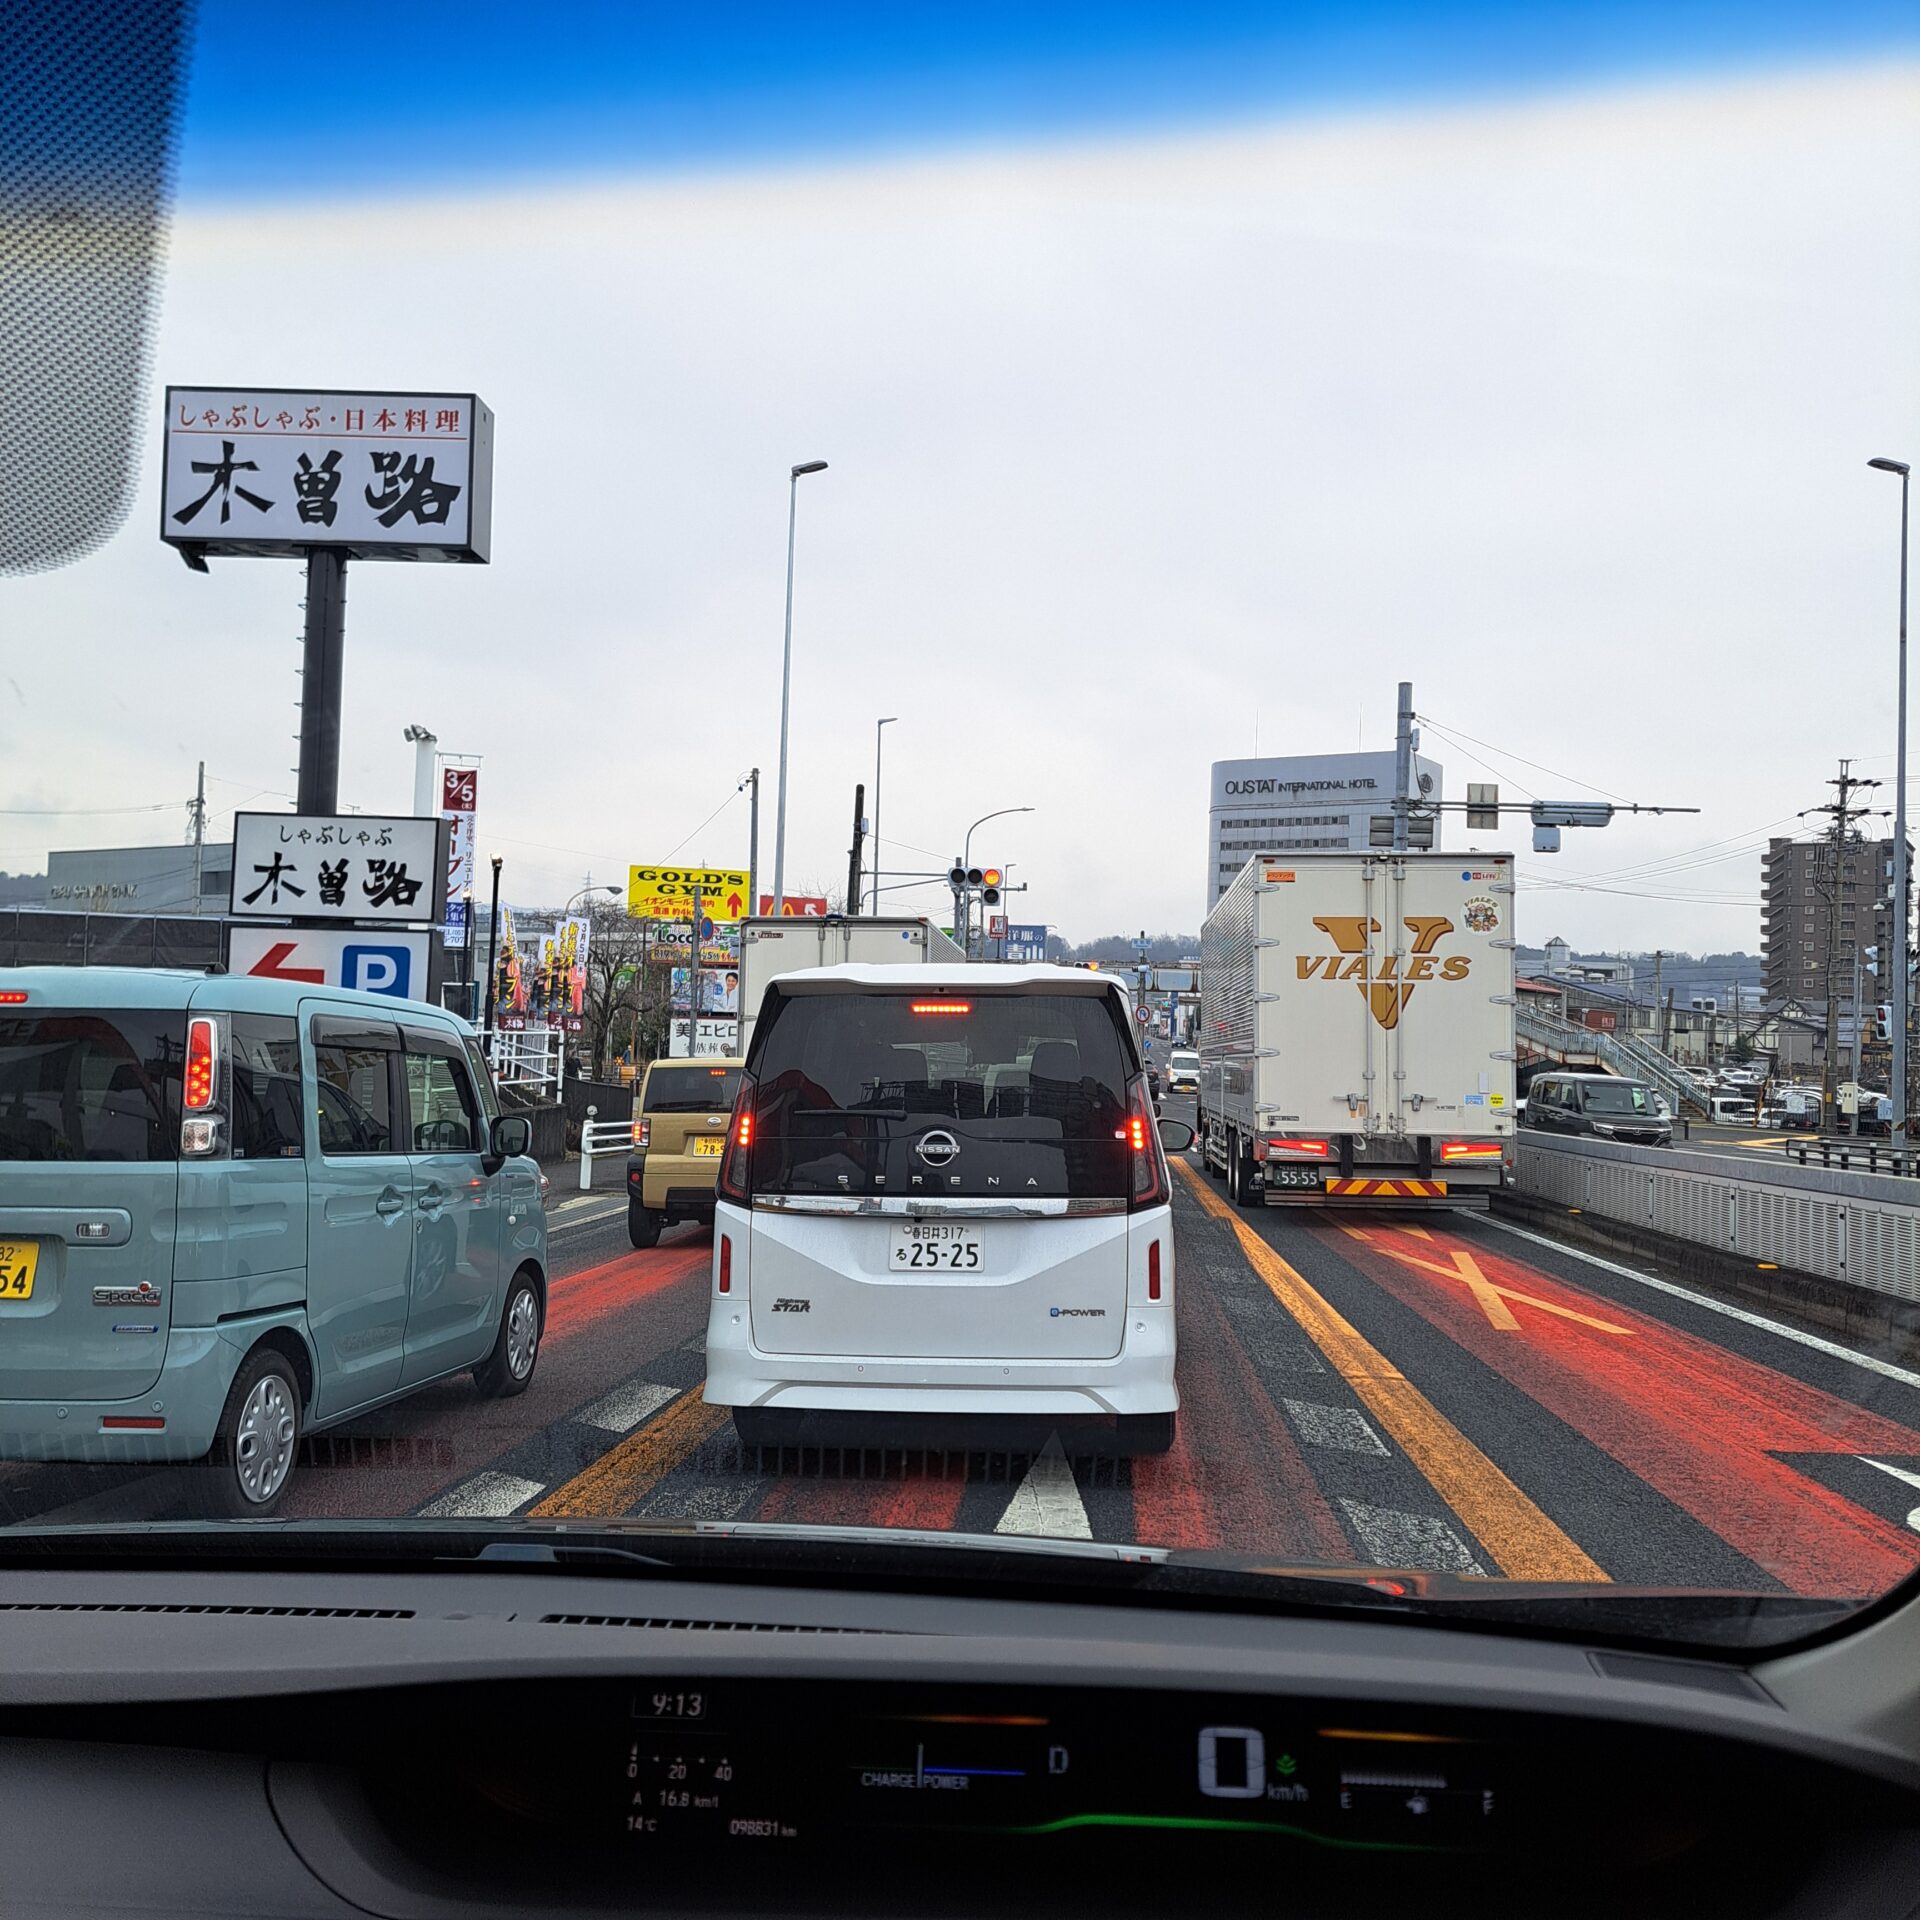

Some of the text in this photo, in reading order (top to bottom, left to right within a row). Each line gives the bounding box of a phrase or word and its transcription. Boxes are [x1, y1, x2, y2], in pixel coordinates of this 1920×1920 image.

[179, 404, 461, 433] しゃぶしゃぶ・日本料理
[172, 440, 462, 528] 木曽路
[446, 771, 473, 802] 3/5
[1225, 778, 1378, 794] OUSTAT INTERNATIONAL HOTEL
[280, 825, 393, 846] しゃぶしゃぶ
[241, 852, 423, 908] 木曽路
[638, 870, 743, 885] GOLD'S
[657, 884, 722, 896] GYM
[356, 954, 398, 993] P
[1295, 956, 1472, 981] VIALES
[837, 1175, 1038, 1186] SERENA
[1281, 1171, 1317, 1185] 55-55
[912, 1227, 964, 1239] 春日井317
[896, 1243, 979, 1267] る 25-25
[94, 1287, 160, 1303] Spacia
[771, 1303, 811, 1313] STAR
[652, 1692, 703, 1716] 9:13
[1048, 1744, 1070, 1774] D
[1197, 1725, 1266, 1799] 0
[626, 1763, 733, 1782] 0 20 40
[860, 1772, 970, 1790] CHARGE POWER
[658, 1789, 690, 1807] 16.8
[1340, 1791, 1352, 1809] E
